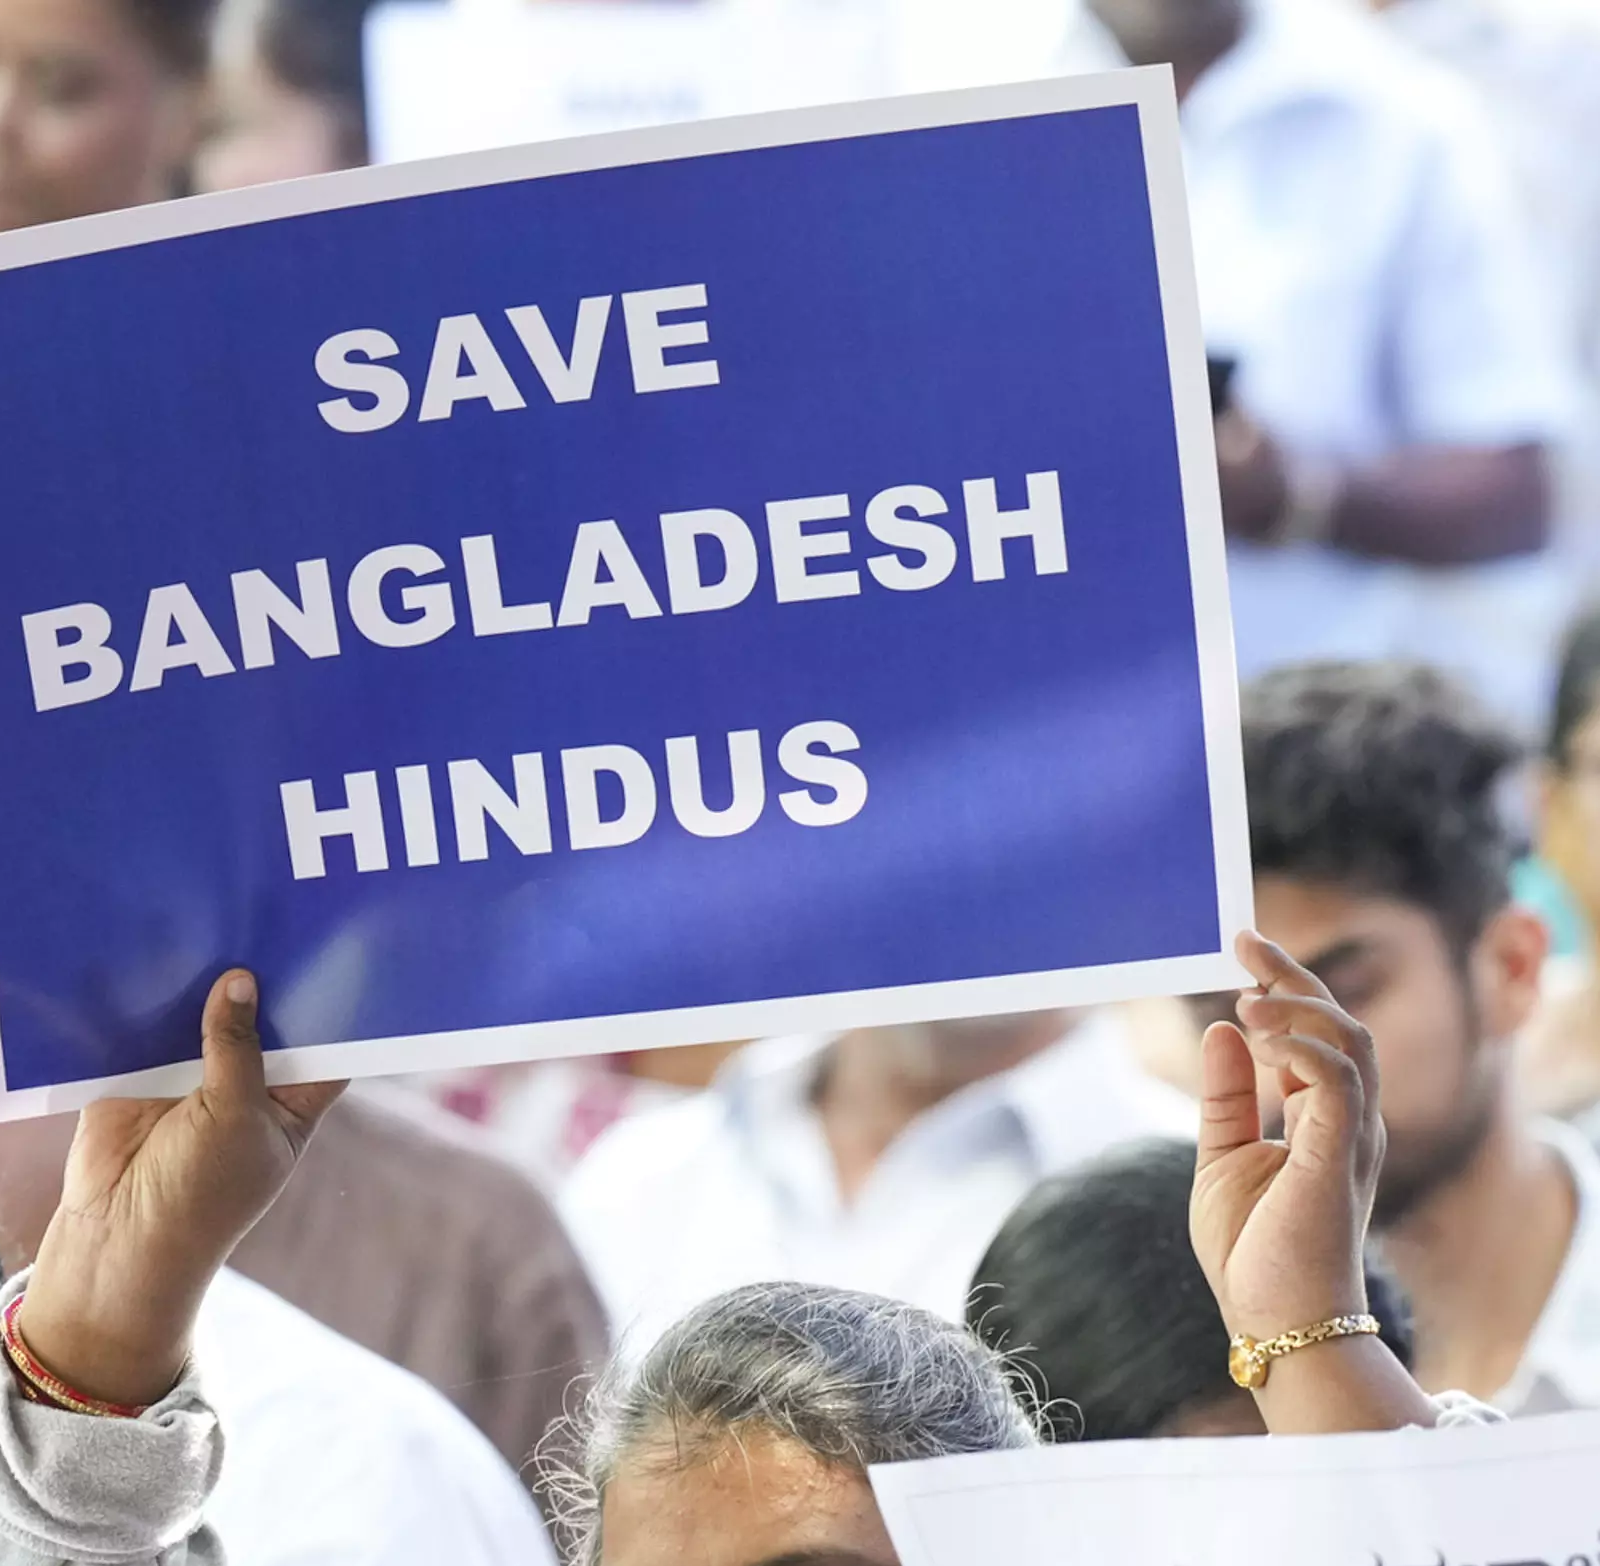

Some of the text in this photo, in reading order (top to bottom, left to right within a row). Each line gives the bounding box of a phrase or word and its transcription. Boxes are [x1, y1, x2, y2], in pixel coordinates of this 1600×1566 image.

[314, 283, 721, 433] SAVE
[21, 470, 1069, 713] BANGLADESH
[279, 720, 868, 880] HINDUS
